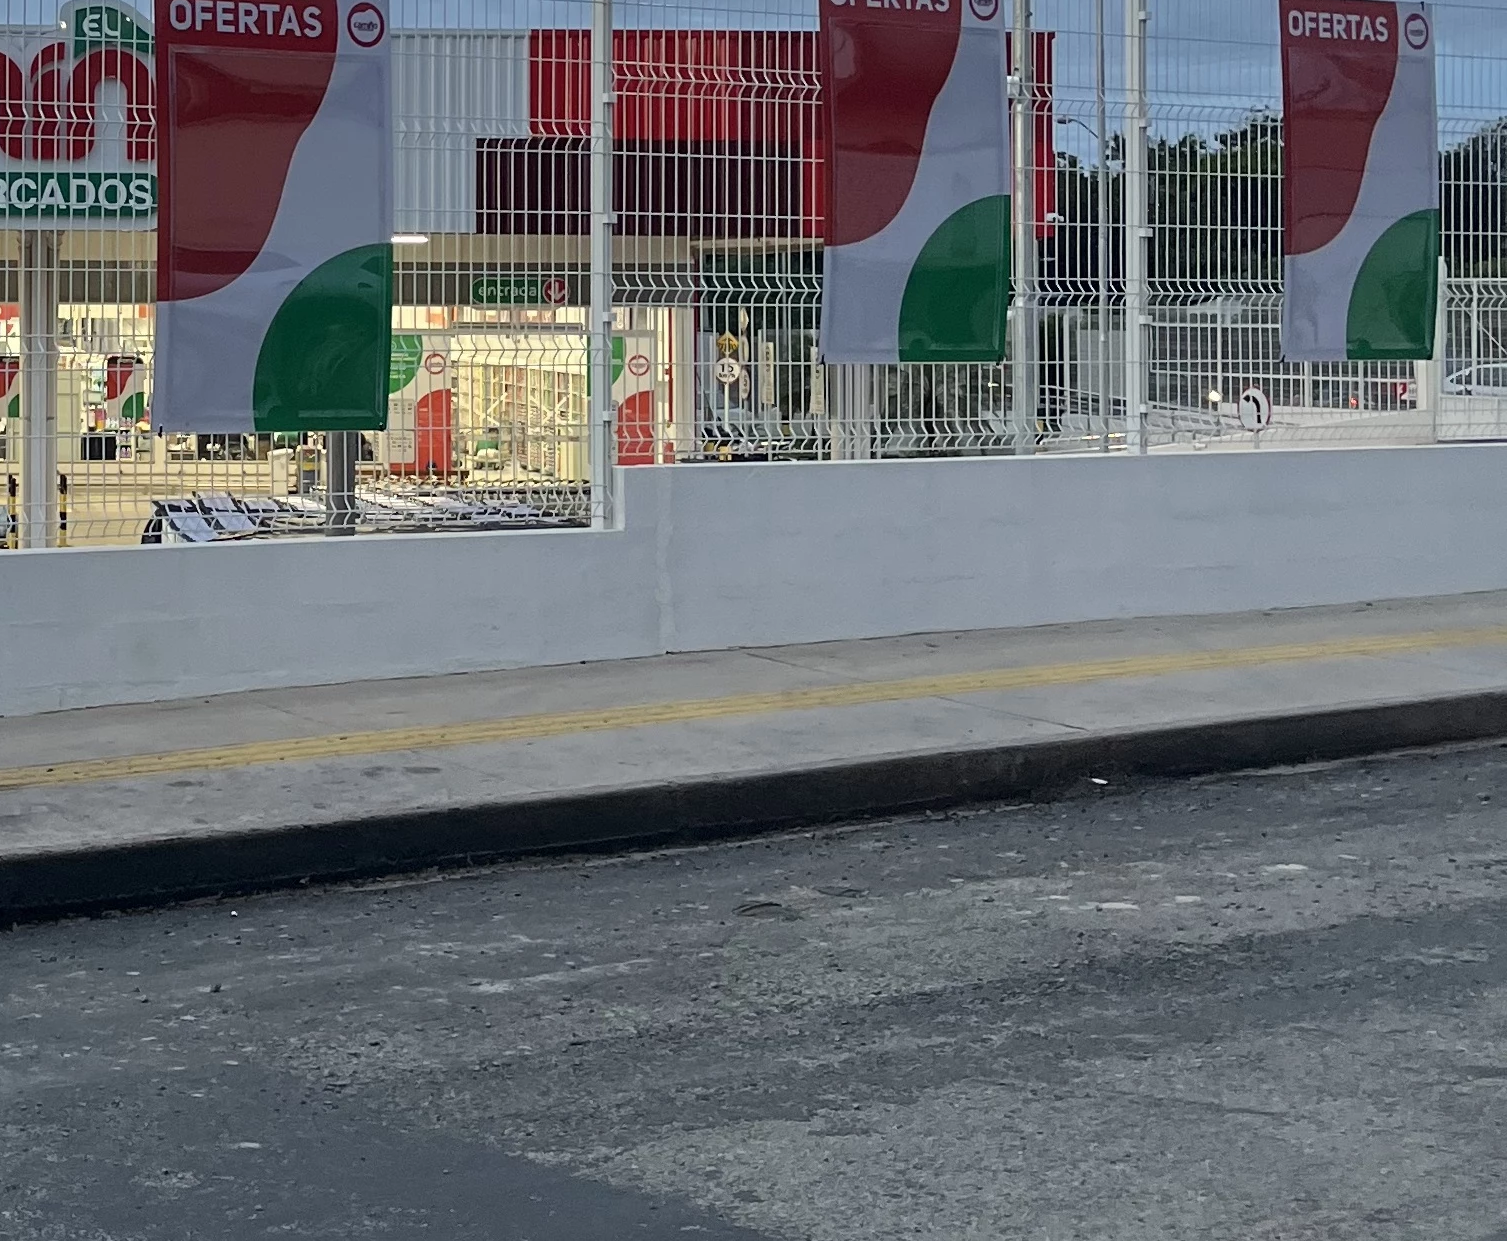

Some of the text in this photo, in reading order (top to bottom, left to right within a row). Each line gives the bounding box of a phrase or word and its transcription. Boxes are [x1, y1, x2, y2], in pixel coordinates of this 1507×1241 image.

[82, 11, 121, 37] EL
[1288, 10, 1389, 42] OFERTAS
[478, 284, 537, 297] entrada
